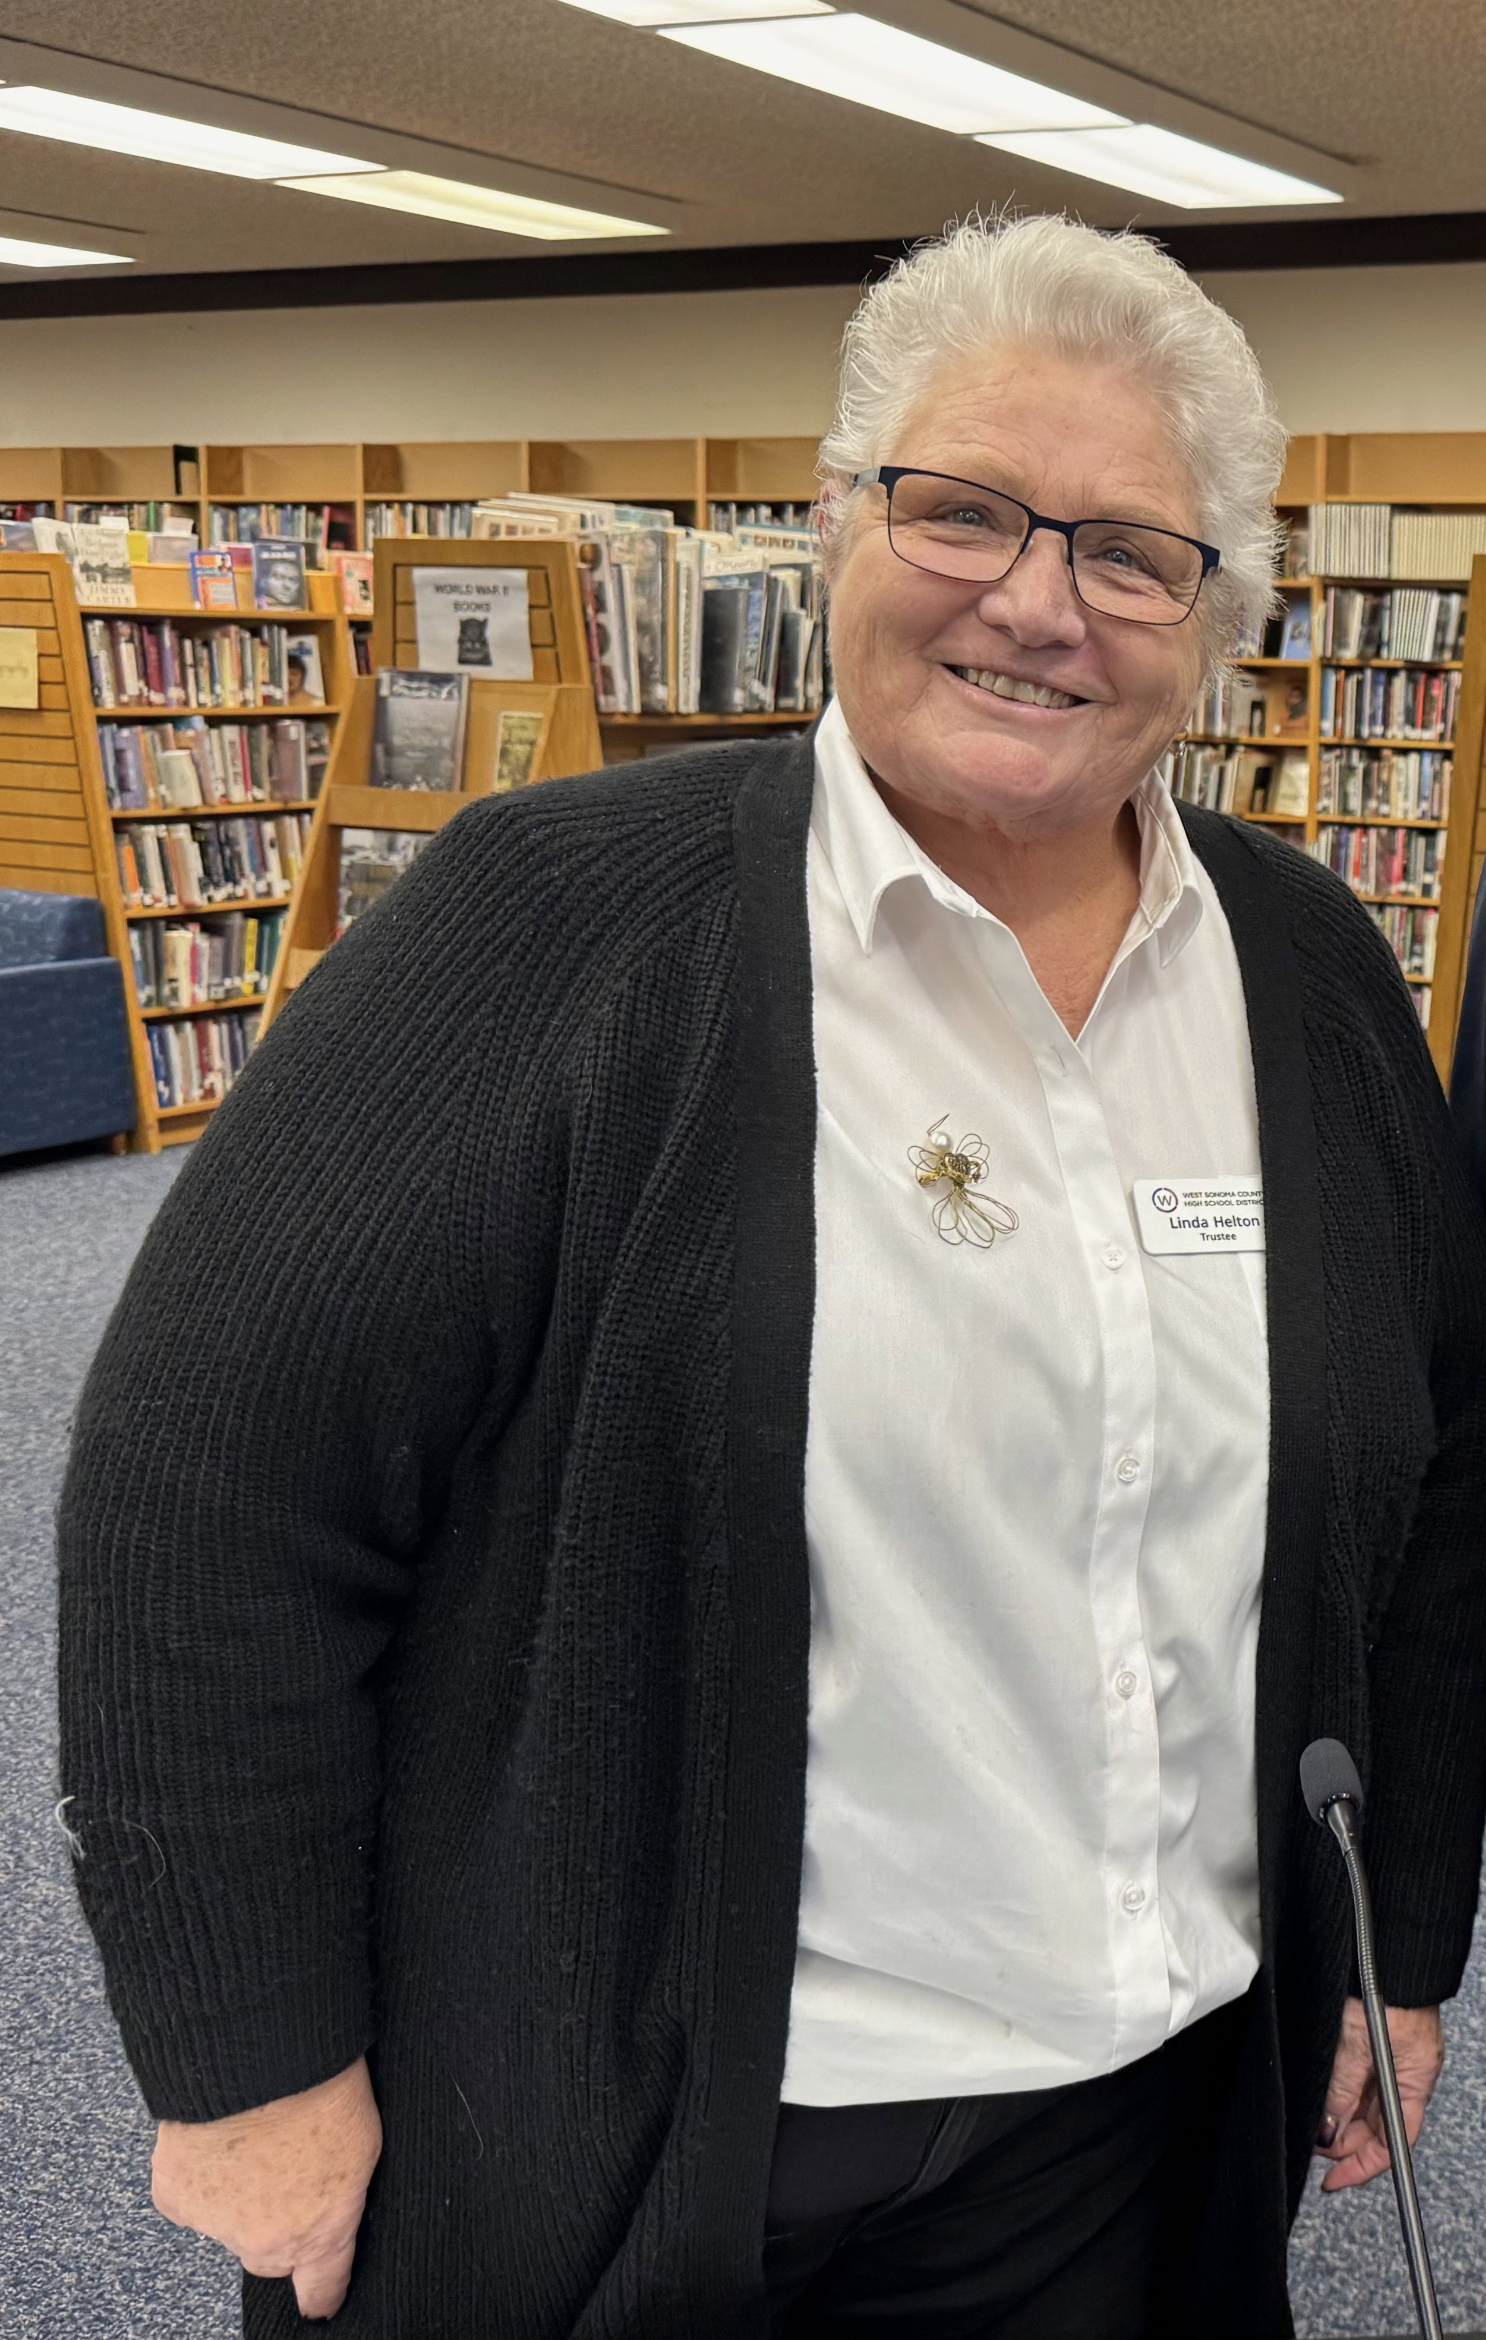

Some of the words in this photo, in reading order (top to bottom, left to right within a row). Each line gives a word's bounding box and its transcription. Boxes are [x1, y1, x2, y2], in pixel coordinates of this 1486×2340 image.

[434, 584, 473, 595] WORLD
[475, 584, 500, 595] WAR
[453, 601, 491, 612] BOOKS
[1182, 1191, 1203, 1199] WEST
[1204, 1191, 1236, 1199] SONOMA
[1169, 1216, 1209, 1229] Linda
[1213, 1215, 1261, 1228] Helton
[1200, 1232, 1237, 1241] Trustee
